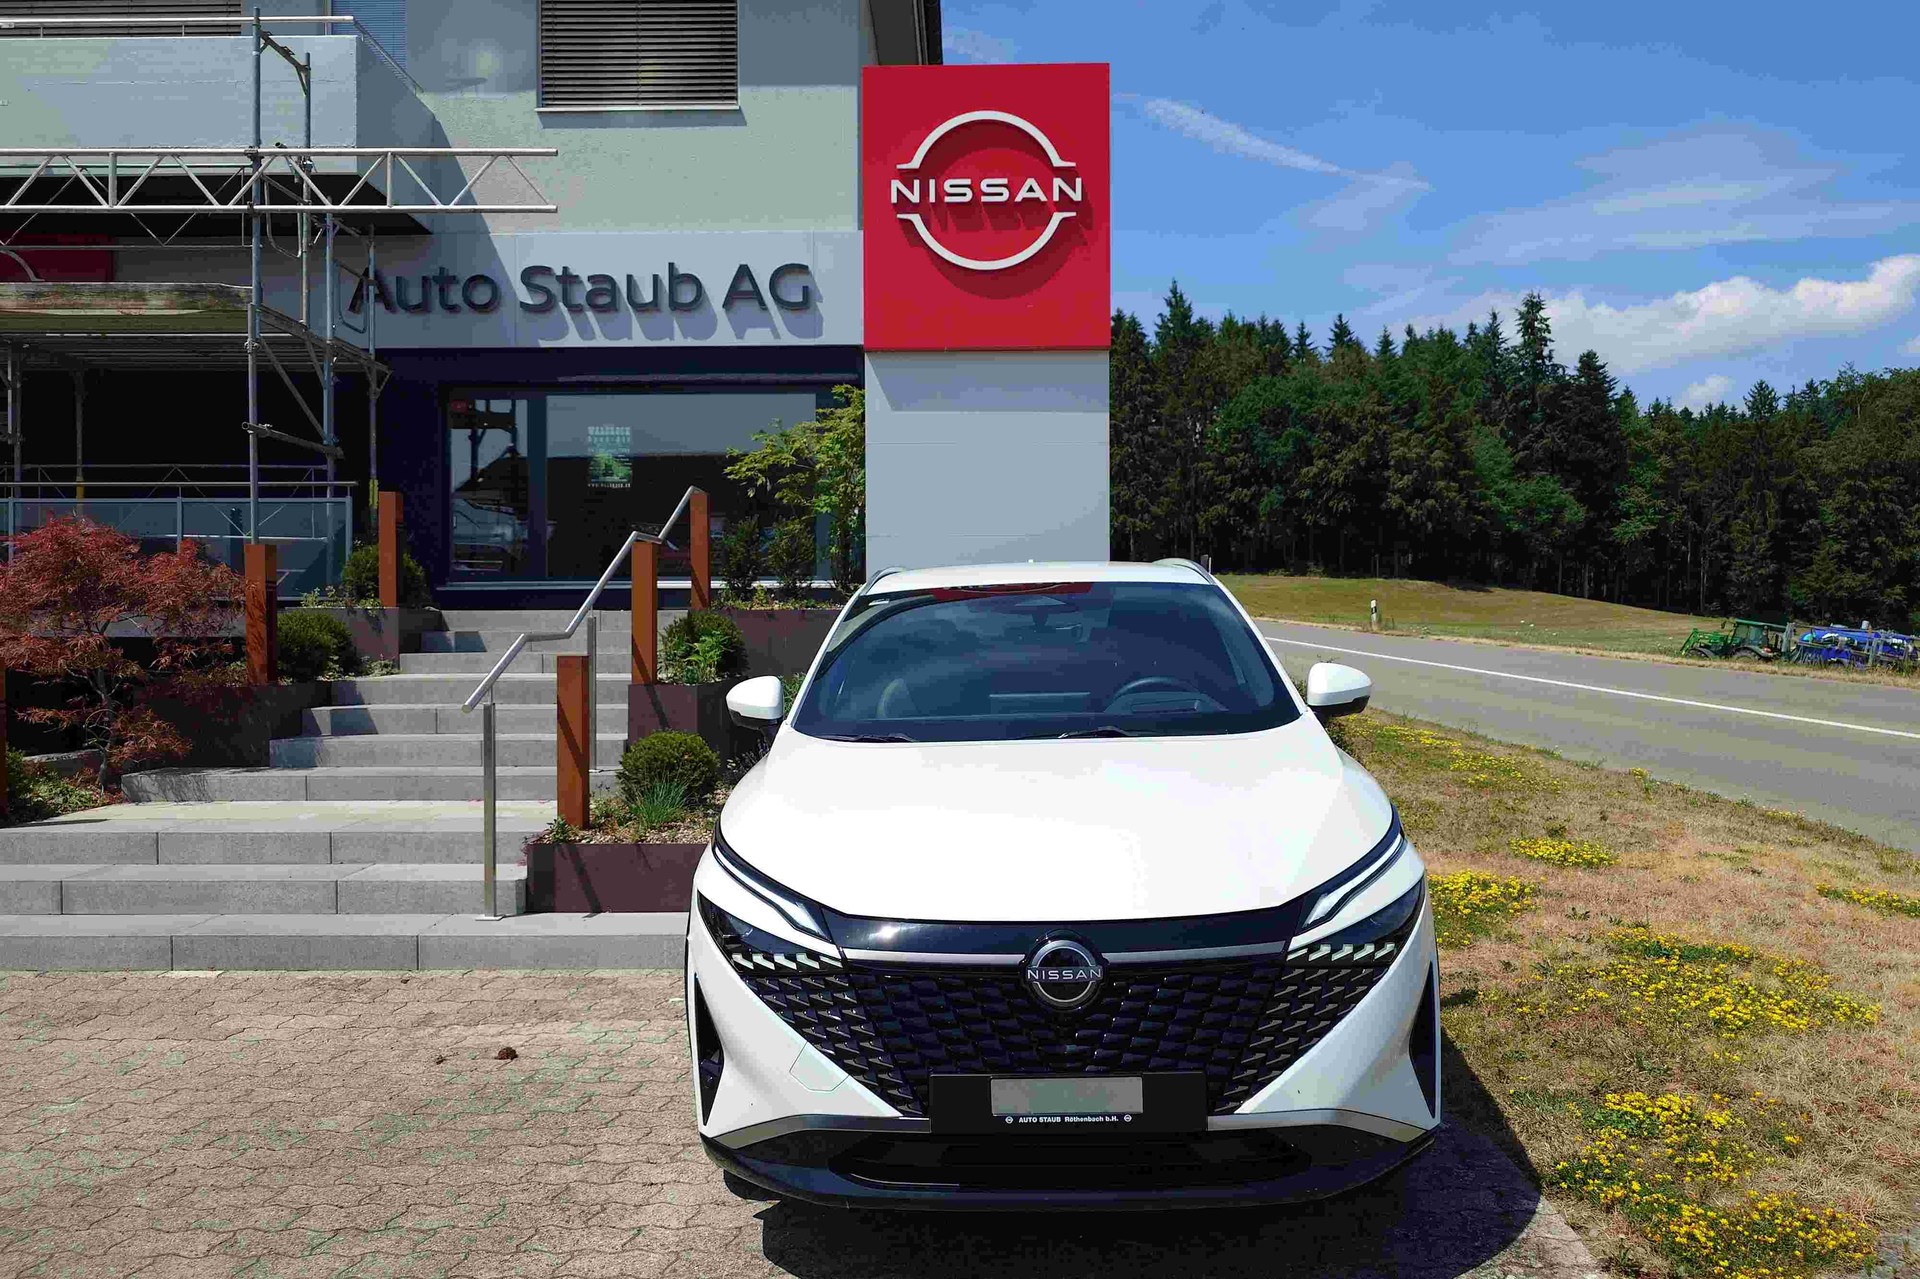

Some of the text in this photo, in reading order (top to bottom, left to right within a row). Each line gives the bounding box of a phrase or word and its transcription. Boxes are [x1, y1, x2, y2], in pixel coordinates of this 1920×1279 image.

[890, 177, 1083, 203] NISSAN
[348, 262, 811, 314] Auto Staub AG
[1027, 968, 1101, 980] NISSAN
